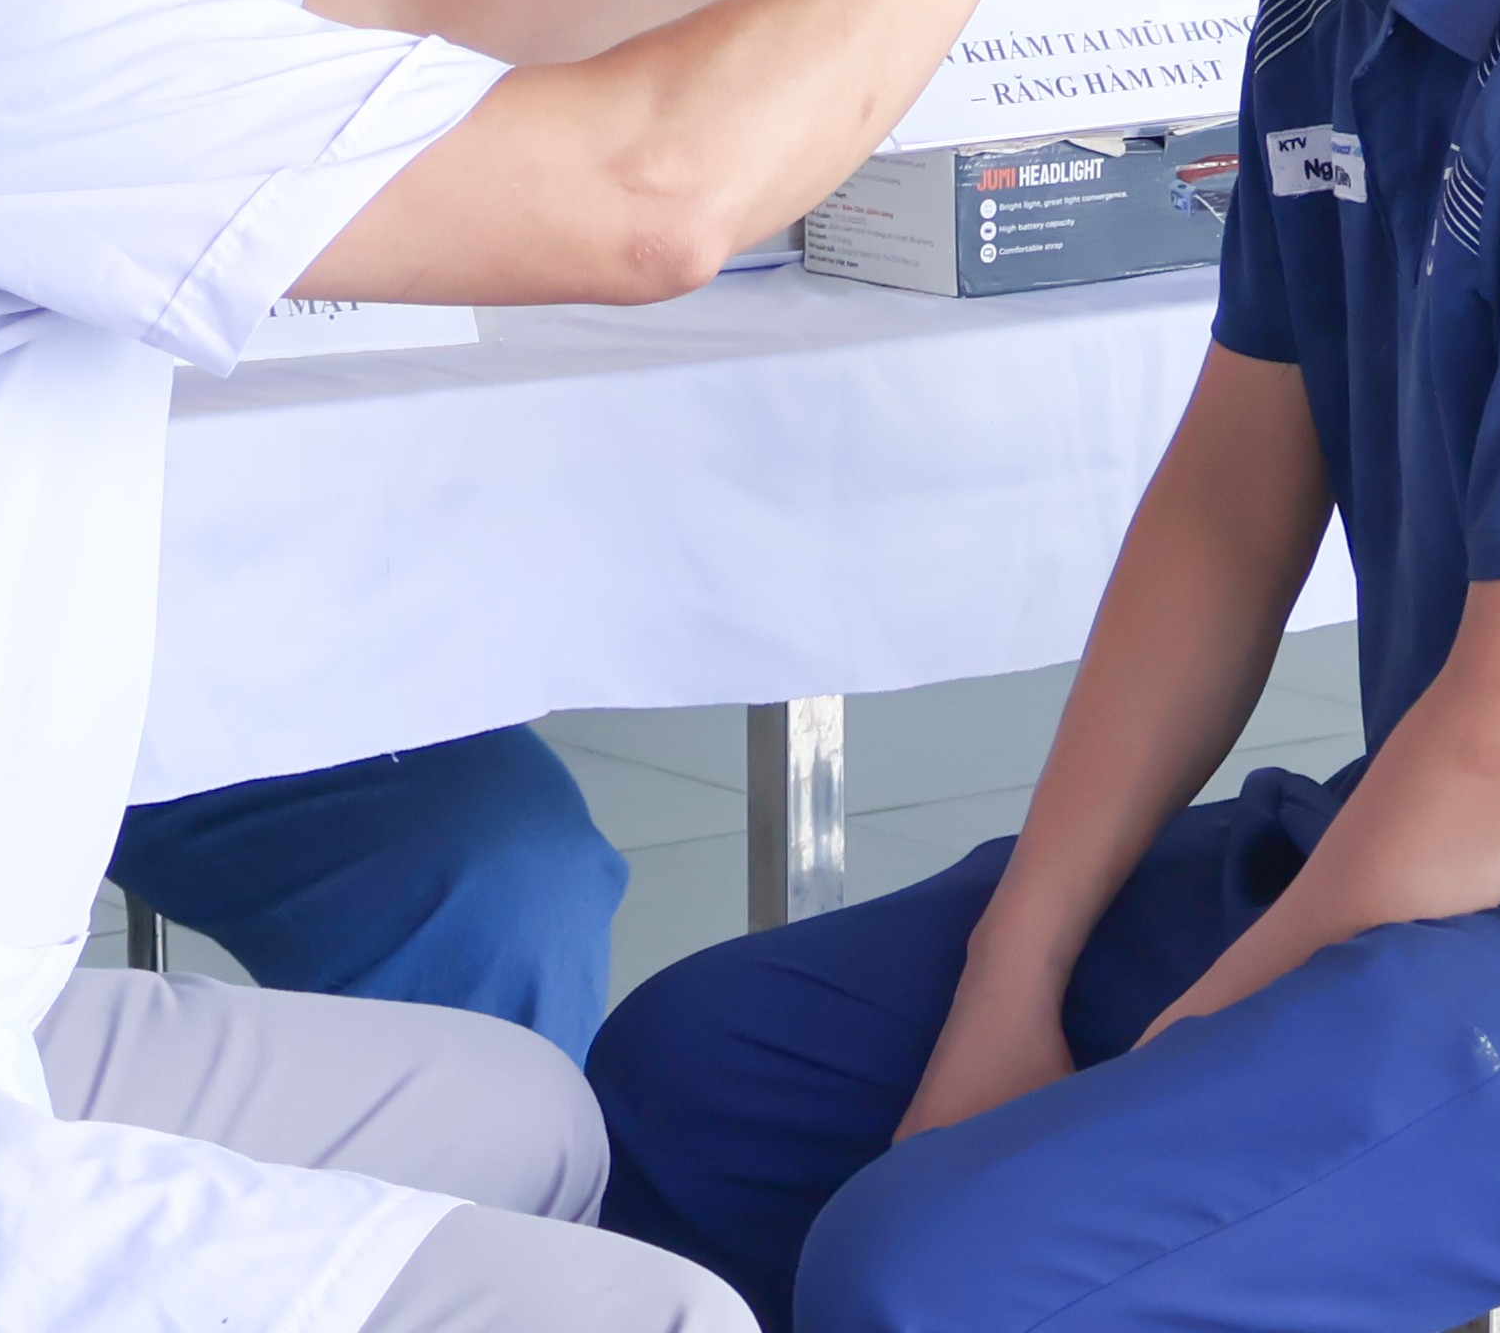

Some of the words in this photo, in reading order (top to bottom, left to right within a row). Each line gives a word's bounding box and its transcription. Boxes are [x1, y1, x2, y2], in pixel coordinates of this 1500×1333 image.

[960, 30, 1056, 64] KHÁM
[1057, 29, 1112, 54] TAI
[1115, 19, 1176, 49] MŨI
[991, 73, 1078, 106] RĂNG
[1082, 64, 1155, 95] HÀM
[1158, 59, 1224, 90] MẶT
[1278, 137, 1306, 152] KTV
[976, 167, 1017, 192] JUMI
[1018, 158, 1104, 188] HEADLIGHT
[999, 201, 1022, 212] Bright
[1044, 198, 1063, 208] great
[1064, 196, 1080, 205] light
[999, 224, 1016, 234] High
[1018, 221, 1044, 231] battery
[1045, 218, 1075, 229] capacity
[999, 244, 1043, 255] Comfortable
[1045, 242, 1063, 251] strap
